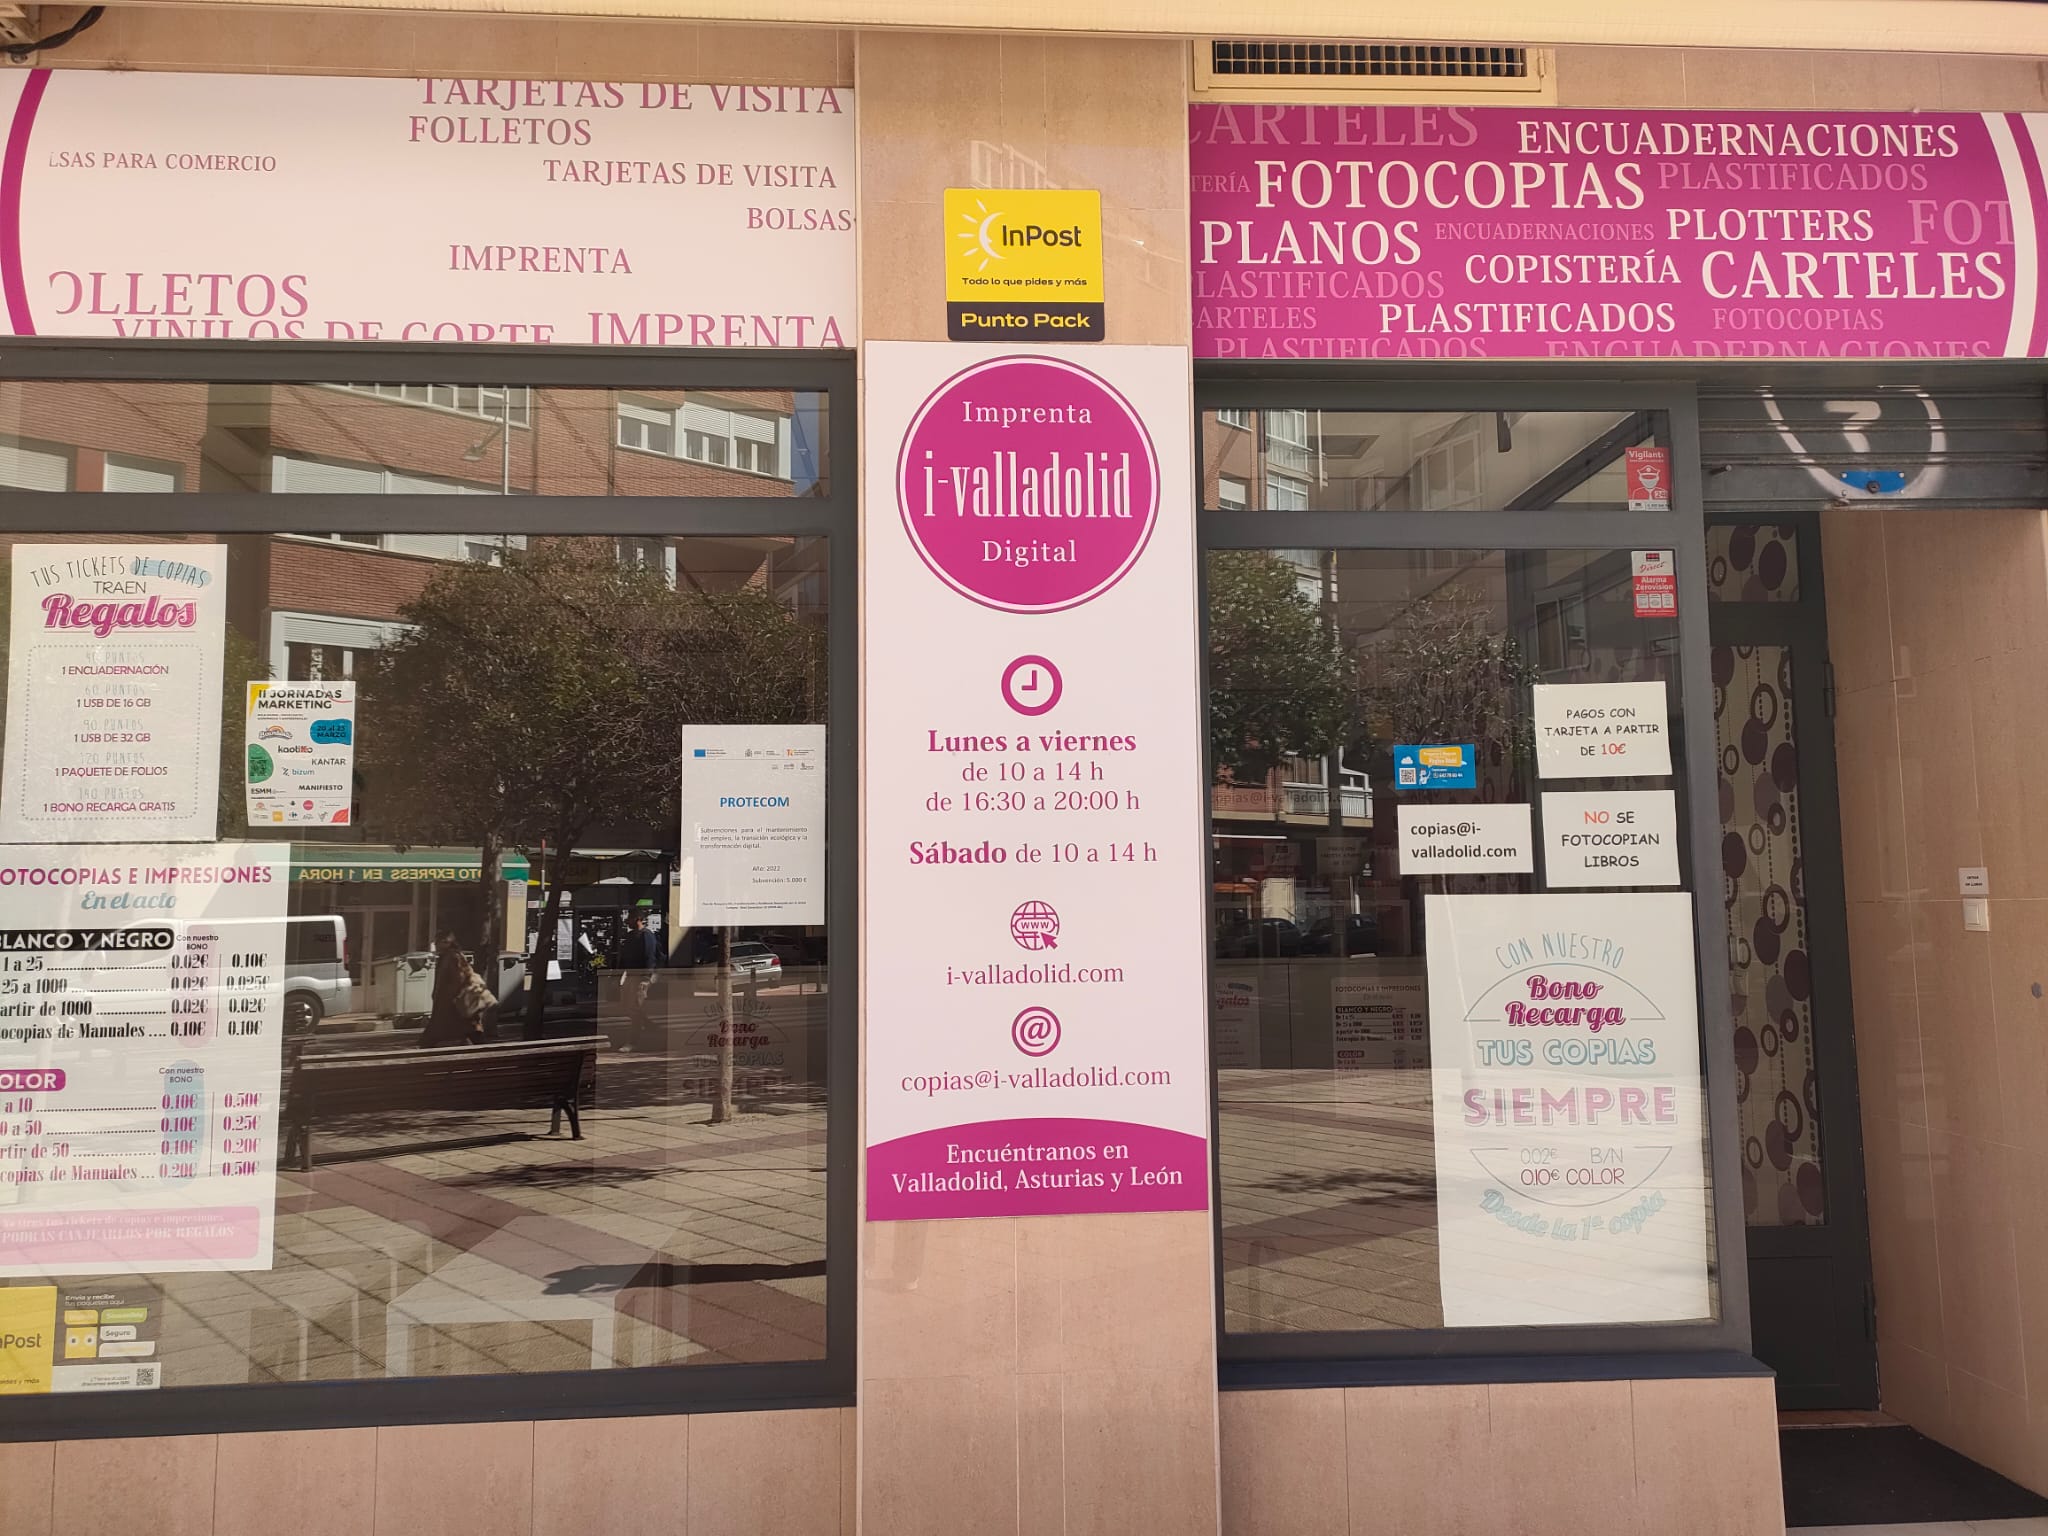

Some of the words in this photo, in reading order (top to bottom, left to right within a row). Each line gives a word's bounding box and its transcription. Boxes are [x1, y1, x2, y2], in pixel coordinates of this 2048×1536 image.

[416, 79, 624, 111] TARJETAS
[639, 82, 693, 110] DE
[710, 84, 843, 114] VISITA
[408, 116, 592, 146] FOLLETOS
[1189, 105, 1478, 147] ARTELES
[1518, 120, 1959, 157] ENCUADERNACIONES
[102, 153, 157, 169] PARA
[165, 153, 276, 172] COMERCIO
[543, 159, 686, 187] TARJETAS
[696, 163, 734, 186] DE
[743, 164, 837, 188] VISITA
[1658, 162, 1928, 191] PLASTIFICADOS
[1254, 160, 1645, 209] FOTOCOPIAS
[747, 207, 852, 231] BOLSAS
[1666, 208, 1874, 241] PLOTTERS
[1001, 224, 1082, 248] InPost
[1434, 222, 1655, 241] ENCUADERNACIONES
[1199, 220, 1421, 265] PLANOS
[448, 244, 633, 274] IMPRENTA
[1465, 248, 1681, 285] COPISTERÍA
[962, 277, 989, 287] Todo
[991, 277, 1000, 286] lo
[1002, 279, 1023, 289] que
[1025, 277, 1053, 289] pides
[1064, 276, 1087, 287] más
[1191, 270, 1445, 299] LASTIFICADOS
[1701, 250, 2006, 300] CARTELES
[961, 312, 1029, 329] Punto
[1033, 312, 1090, 329] Pack
[1192, 306, 1317, 329] ARTELES
[1380, 302, 1675, 334] PLASTIFICADOS
[1712, 308, 1884, 331] FOTOCOPIAS
[588, 312, 846, 347] IMPRENTA
[962, 401, 1092, 429] Imprenta
[923, 450, 1133, 519] i-valladolid
[981, 540, 1077, 567] Digital
[30, 564, 60, 588] TUS
[66, 556, 125, 579] TICKETS
[134, 556, 150, 577] DE
[157, 559, 208, 588] COPIAS
[93, 581, 146, 595] TRAEN
[41, 593, 197, 639] Regalos
[68, 665, 169, 675] ENCUADERNACIÓN
[83, 698, 104, 708] USB
[106, 698, 121, 708] DE
[123, 698, 134, 708] 16
[136, 698, 151, 708] GB
[270, 689, 342, 698] JORNADAS
[258, 700, 332, 709] MARKETING
[1566, 708, 1605, 719] PAGOS
[1609, 707, 1636, 718] CON
[81, 733, 102, 743] USB
[104, 733, 118, 743] DE
[120, 733, 134, 742] 32
[135, 733, 151, 742] GB
[1544, 725, 1598, 737] TARJETA
[1616, 723, 1660, 735] PARTIR
[927, 730, 1007, 753] Lunes
[1016, 737, 1030, 752] a
[1039, 729, 1137, 752] viernes
[1580, 745, 1596, 756] DE
[1601, 742, 1627, 756] 10€
[62, 767, 112, 778] PAQUETE
[114, 767, 129, 776] DE
[131, 766, 168, 776] FOLIOS
[311, 758, 346, 766] KANTAR
[961, 763, 988, 782] de
[998, 763, 1026, 782] 10
[1033, 767, 1045, 782] a
[1055, 762, 1083, 781] 14
[1089, 762, 1104, 781] h
[51, 803, 84, 812] BONO
[86, 802, 137, 812] RECARGA
[139, 802, 175, 812] GRATIS
[719, 797, 790, 808] PROTECOM
[925, 793, 952, 813] de
[962, 792, 1026, 812] 16:30
[1033, 796, 1045, 812] a
[1053, 791, 1119, 811] 20:00
[1125, 790, 1140, 810] h
[1584, 810, 1610, 824] NO
[1616, 811, 1635, 824] SE
[1410, 822, 1481, 838] copias@i-
[1561, 833, 1660, 847] FOTOCOPIAN
[909, 841, 1006, 865] Sábado
[1015, 844, 1042, 863] de
[1051, 843, 1079, 863] 10
[1086, 848, 1098, 862] a
[1108, 843, 1135, 862] 14
[1143, 842, 1158, 862] h
[1411, 844, 1518, 859] valladolid.com
[1584, 855, 1640, 868] LIBROS
[0, 868, 121, 886] OTOCOPIAS
[129, 868, 137, 885] E
[145, 866, 272, 885] IMPRESIONES
[81, 891, 108, 910] En
[110, 891, 130, 910] el
[132, 892, 176, 909] acto
[0, 933, 73, 949] LANCO
[80, 932, 95, 948] Y
[101, 932, 171, 948] NEGRO
[193, 934, 219, 942] nuestro
[1495, 937, 1533, 969] CON
[1542, 932, 1624, 969] NUESTRO
[26, 956, 43, 971] 25
[171, 954, 209, 969] 0.02€
[231, 953, 268, 968] 0.10€
[946, 963, 1124, 986] i-valladolid.com
[2, 979, 19, 994] 25
[36, 978, 68, 994] 1000
[1526, 975, 1604, 1000] Bono
[40, 1001, 56, 1016] de
[61, 1000, 92, 1015] 1000
[171, 998, 209, 1014] 0.02€
[228, 998, 266, 1014] 0.02€
[1504, 1001, 1627, 1033] Recarga
[79, 1022, 145, 1038] Manuales
[170, 1021, 207, 1037] 0.10€
[228, 1020, 262, 1036] 0.10€
[1476, 1039, 1534, 1066] TUS
[1542, 1038, 1656, 1066] COPIAS
[900, 1065, 1172, 1097] copias@i-valladolid.com
[162, 1093, 198, 1110] 0.10€
[1463, 1086, 1679, 1127] SIEMPRE
[945, 1142, 1097, 1165] Encuéntranos
[1103, 1144, 1129, 1160] en
[1590, 1147, 1624, 1164] B/N
[71, 1164, 137, 1181] Manuales
[891, 1170, 1009, 1194] Valladolid,
[1014, 1167, 1105, 1190] Asturias
[1110, 1172, 1124, 1192] y
[1130, 1165, 1183, 1187] León
[1520, 1168, 1560, 1186] 0.10€
[1566, 1168, 1625, 1186] COLOR
[1479, 1189, 1549, 1237] Desde
